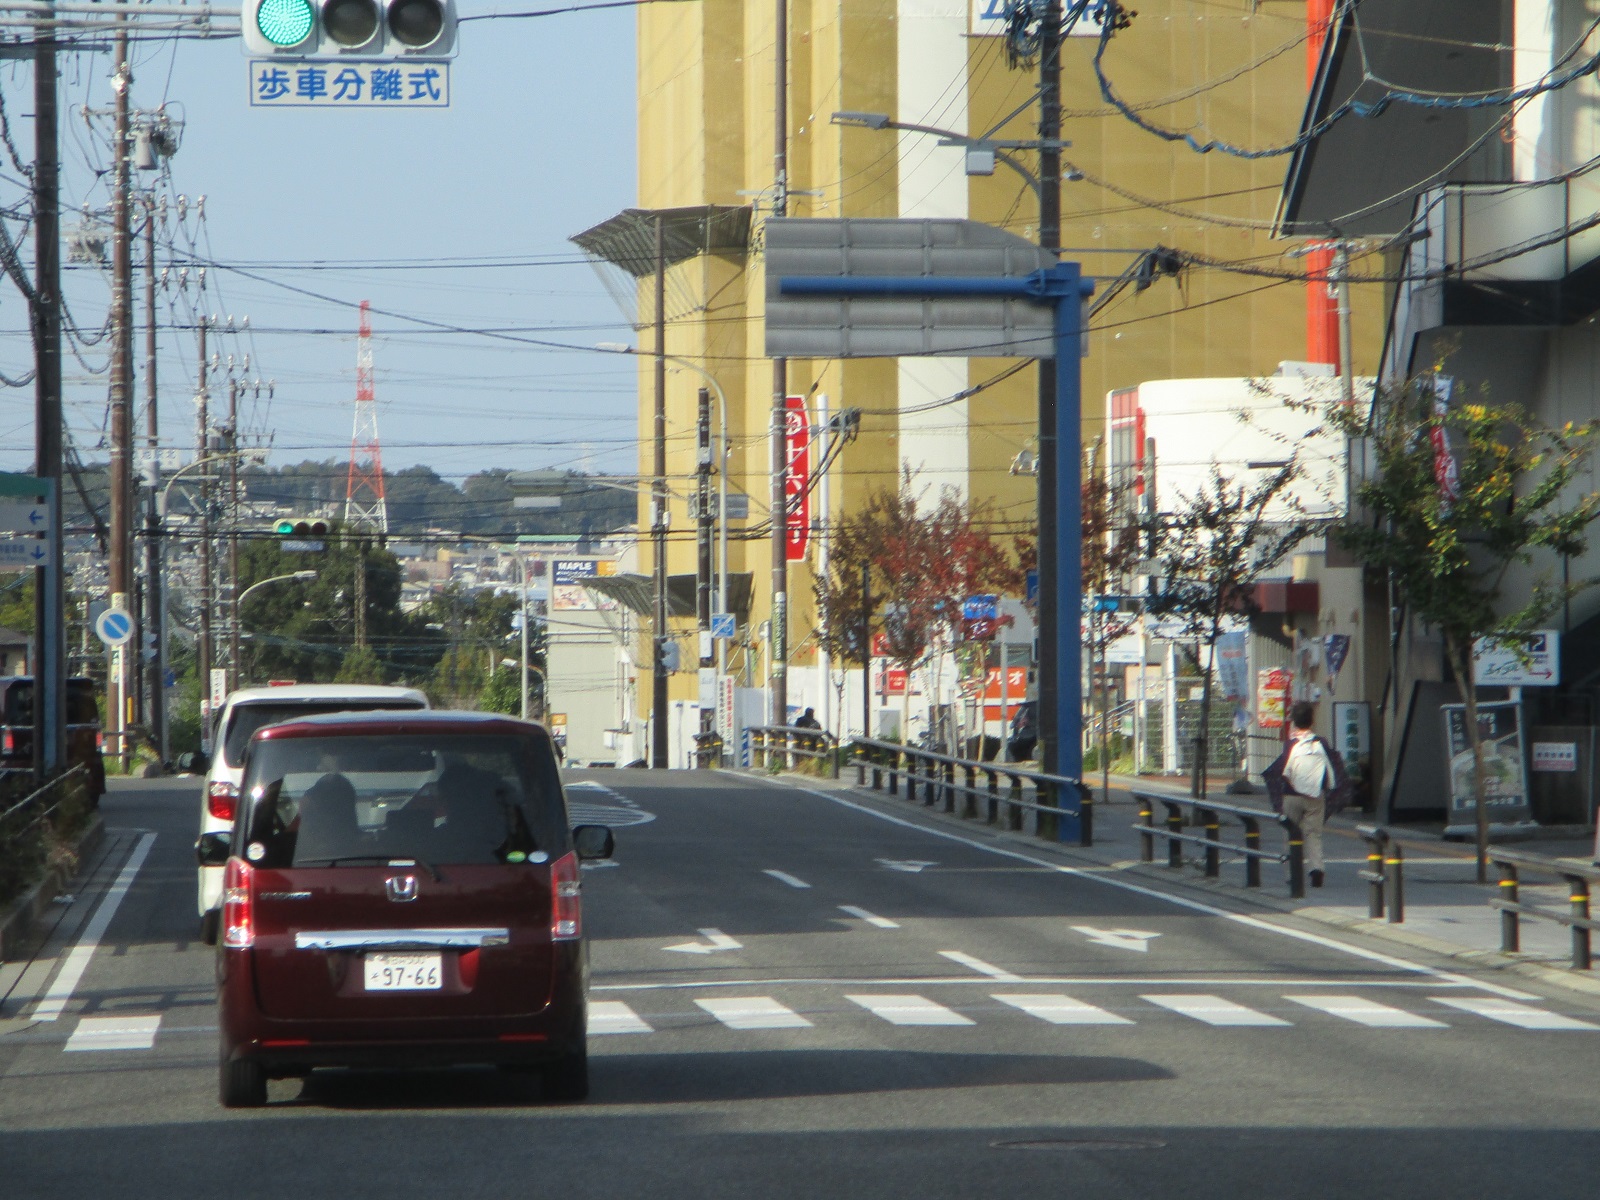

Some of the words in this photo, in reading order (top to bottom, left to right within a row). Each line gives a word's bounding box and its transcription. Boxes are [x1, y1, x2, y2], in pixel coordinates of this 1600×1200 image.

[258, 67, 440, 101] 歩車分離式
[557, 561, 593, 571] MAPLE
[383, 966, 437, 986] 97-66
